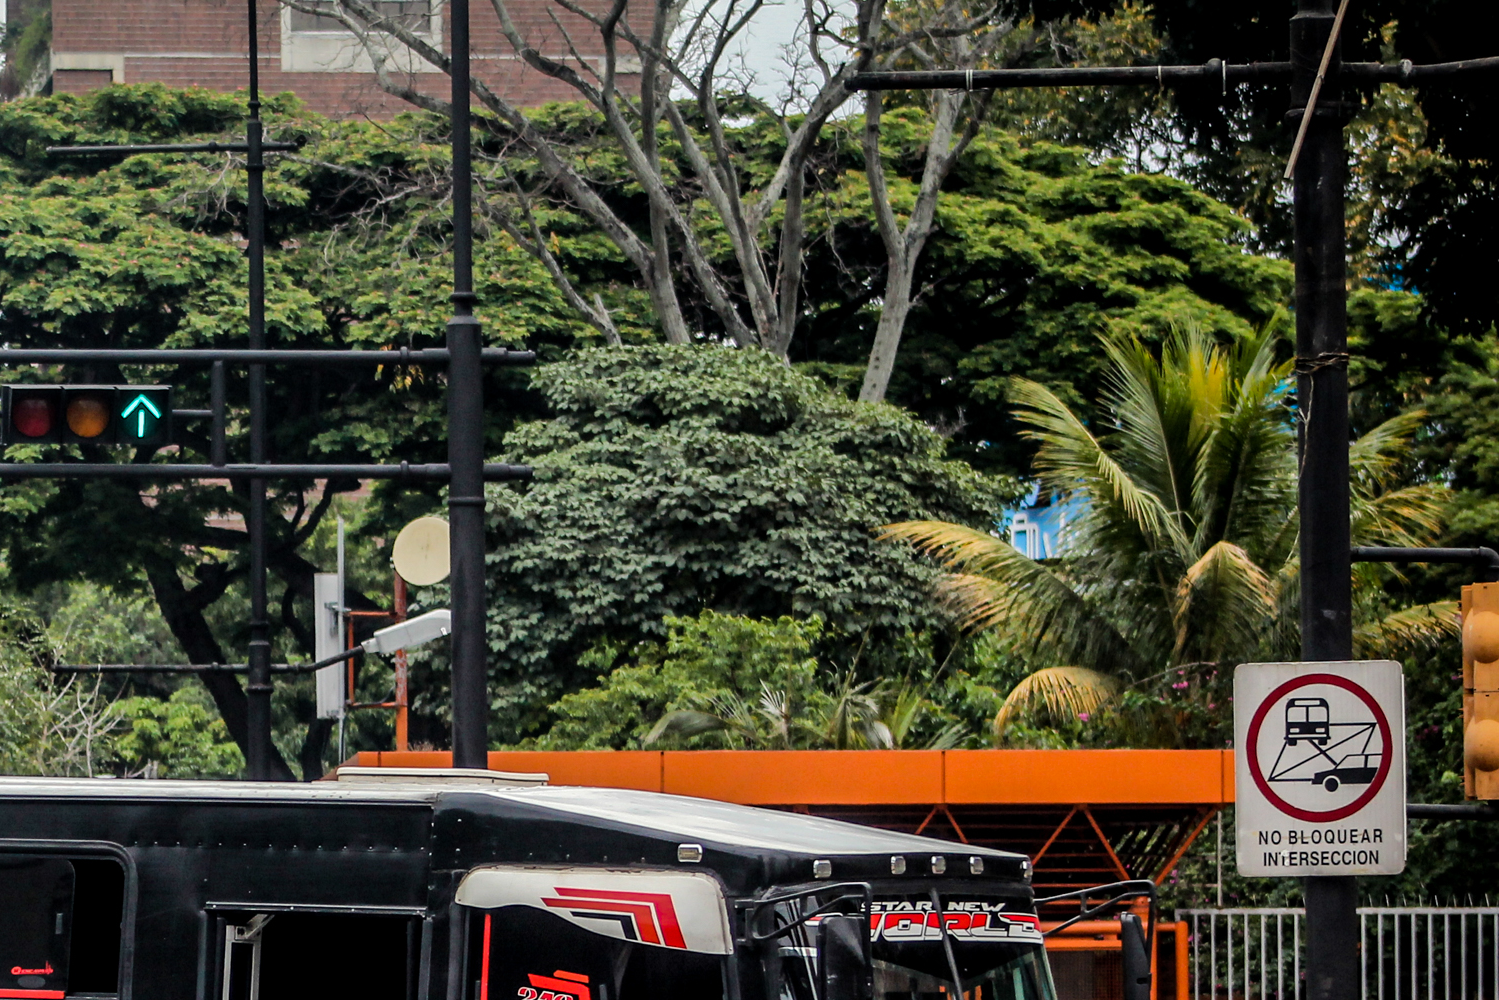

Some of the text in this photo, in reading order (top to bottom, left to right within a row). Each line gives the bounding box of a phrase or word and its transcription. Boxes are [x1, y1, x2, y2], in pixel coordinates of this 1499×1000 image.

[1258, 828, 1383, 845] NO BLOQUEAR
[1263, 850, 1379, 867] INTERSECCION
[860, 901, 1006, 912] STAR NEW
